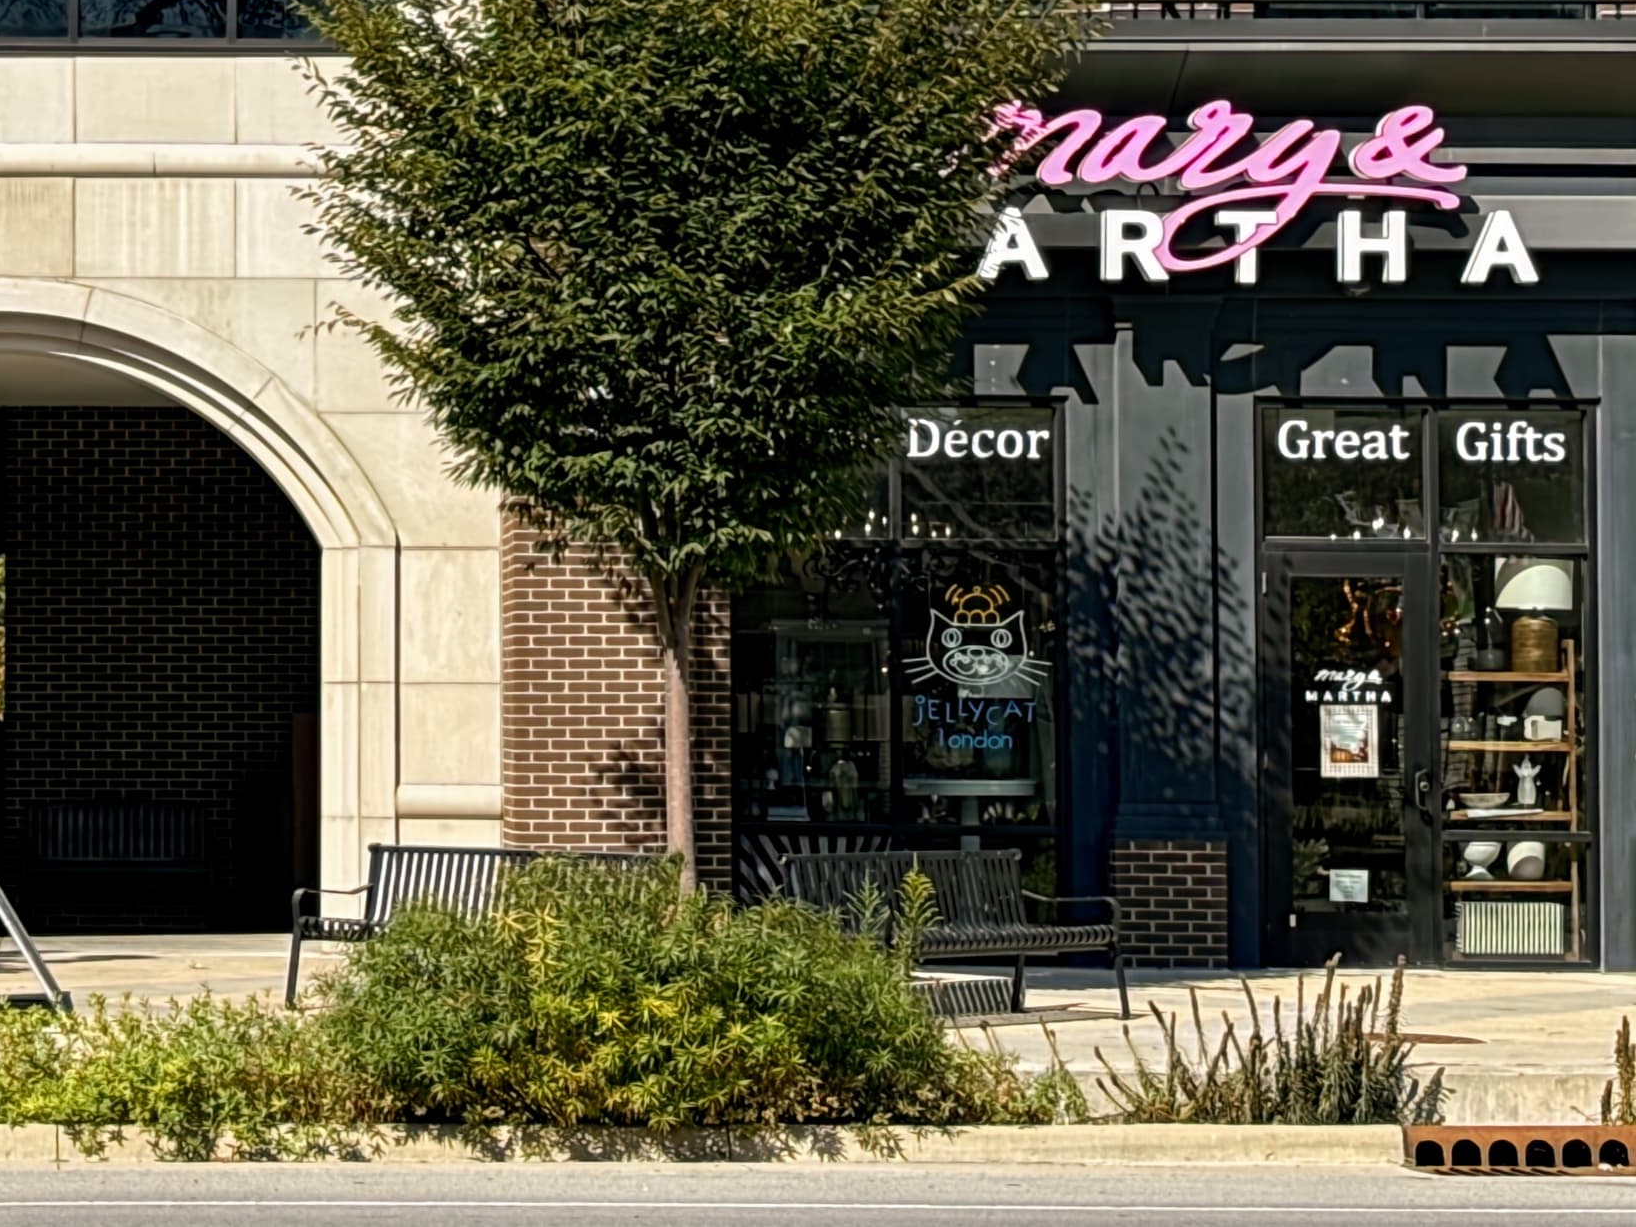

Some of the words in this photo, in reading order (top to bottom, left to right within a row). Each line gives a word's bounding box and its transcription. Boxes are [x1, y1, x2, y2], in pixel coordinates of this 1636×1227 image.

[1348, 104, 1468, 182] &
[978, 206, 1539, 284] ARTHA
[906, 418, 1050, 459] Décor
[1277, 420, 1410, 461] Great
[1455, 421, 1566, 462] Gifts
[1305, 690, 1392, 703] MARTHA
[938, 729, 1014, 750] london
